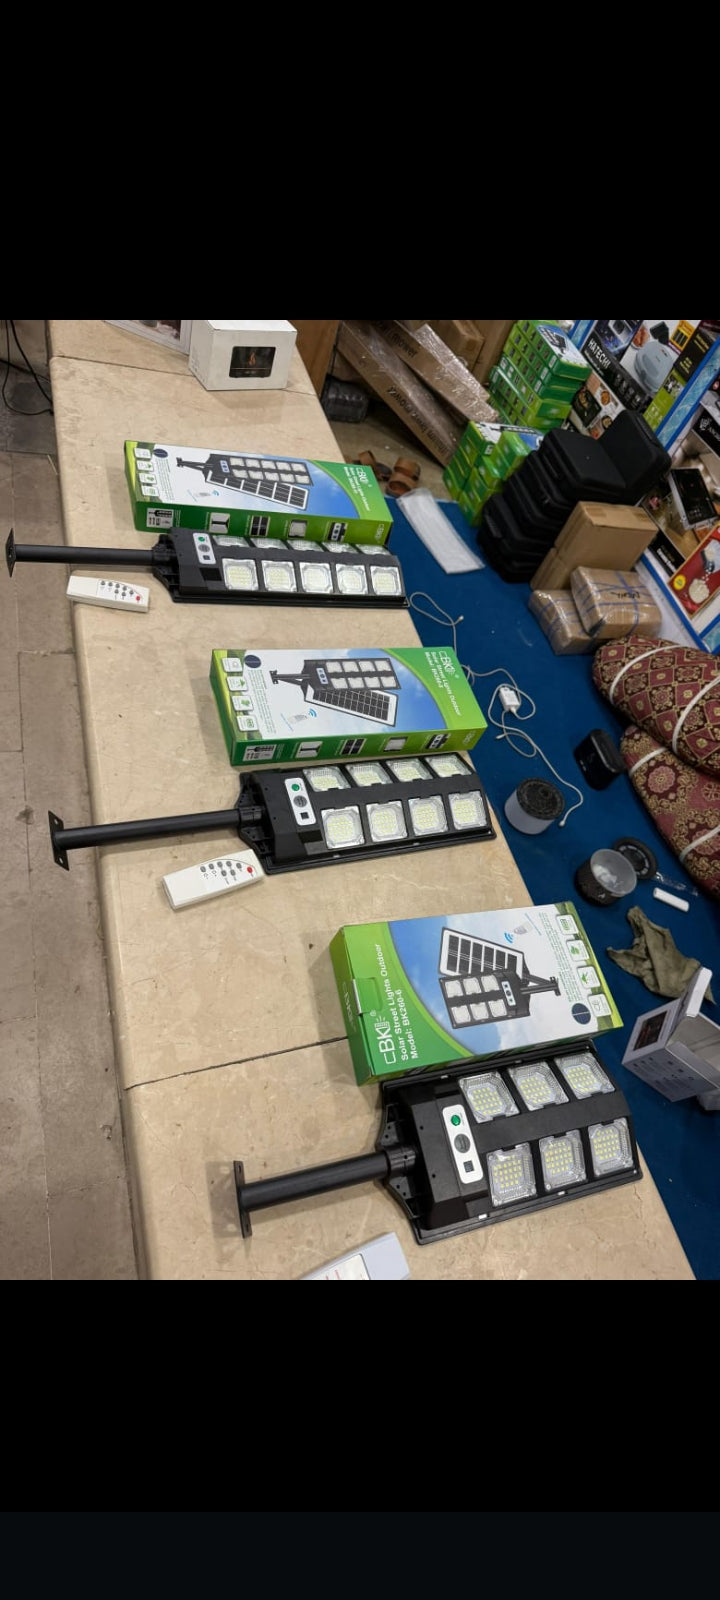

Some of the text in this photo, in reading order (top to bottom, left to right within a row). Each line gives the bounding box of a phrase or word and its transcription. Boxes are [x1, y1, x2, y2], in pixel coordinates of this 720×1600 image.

[588, 338, 611, 369] HATECHI
[375, 944, 409, 1061] Solar Street Lights Outdoor
[405, 1028, 419, 1059] Model:
